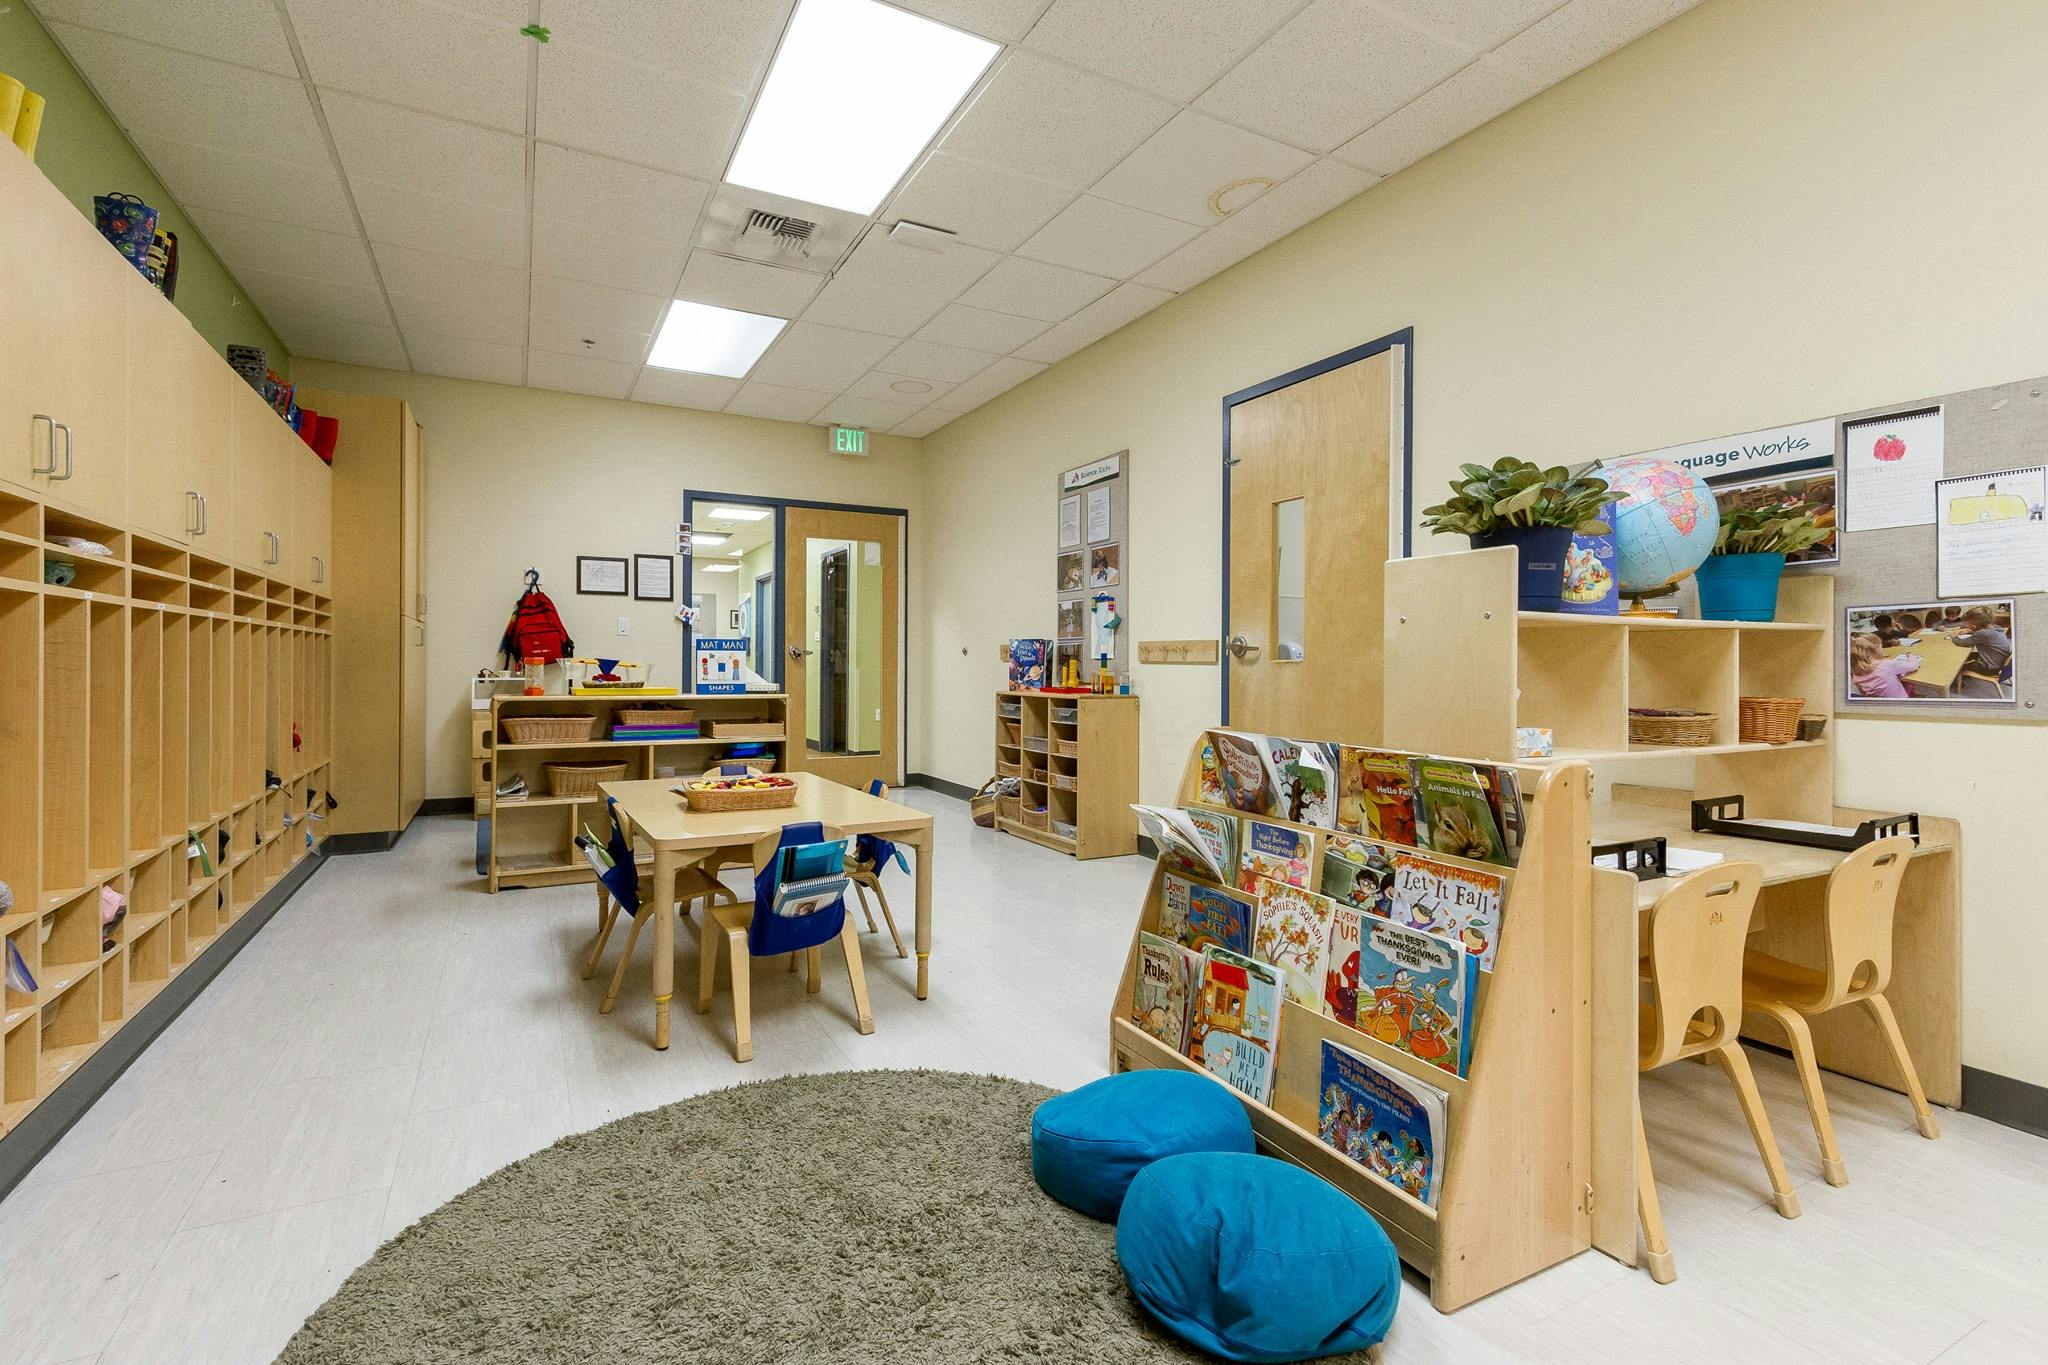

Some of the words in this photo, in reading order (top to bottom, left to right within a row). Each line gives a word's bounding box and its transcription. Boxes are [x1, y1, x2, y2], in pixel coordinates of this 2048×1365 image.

[837, 428, 865, 453] EXIT
[1675, 450, 1740, 470] guage
[1742, 435, 1811, 460] Works
[1080, 470, 1097, 480] Science
[700, 640, 719, 650] MAT
[722, 640, 744, 650] MAN
[1222, 740, 1260, 771] Substitute
[1226, 756, 1260, 784] Groundhog
[1376, 785, 1397, 795] Hello
[1427, 783, 1460, 796] Animals
[1460, 788, 1470, 797] in
[1471, 790, 1485, 800] Fall
[1269, 828, 1280, 836] The
[1272, 835, 1290, 847] Before
[1256, 839, 1294, 858] Thanksgiving
[1168, 891, 1187, 912] Barn
[1402, 870, 1428, 891] Let
[1435, 876, 1449, 899] It
[1454, 884, 1488, 915] Fall
[1263, 900, 1298, 921] SOPHIE'S
[1299, 905, 1324, 945] SQUASH
[1340, 909, 1360, 924] VERY
[1388, 930, 1405, 941] THE
[1404, 933, 1428, 947] BEST
[1141, 944, 1171, 966] Thanksgiving
[1375, 935, 1444, 964] THANKSGIVING
[1395, 952, 1422, 967] EVER!
[1144, 958, 1170, 984] Rules
[1235, 1040, 1266, 1069] BUILD
[1238, 1062, 1251, 1076] ME
[1252, 1070, 1259, 1081] A
[1352, 1061, 1366, 1074] the
[1229, 1071, 1262, 1100] HOME
[1337, 1063, 1413, 1117] THANKSGIVING
